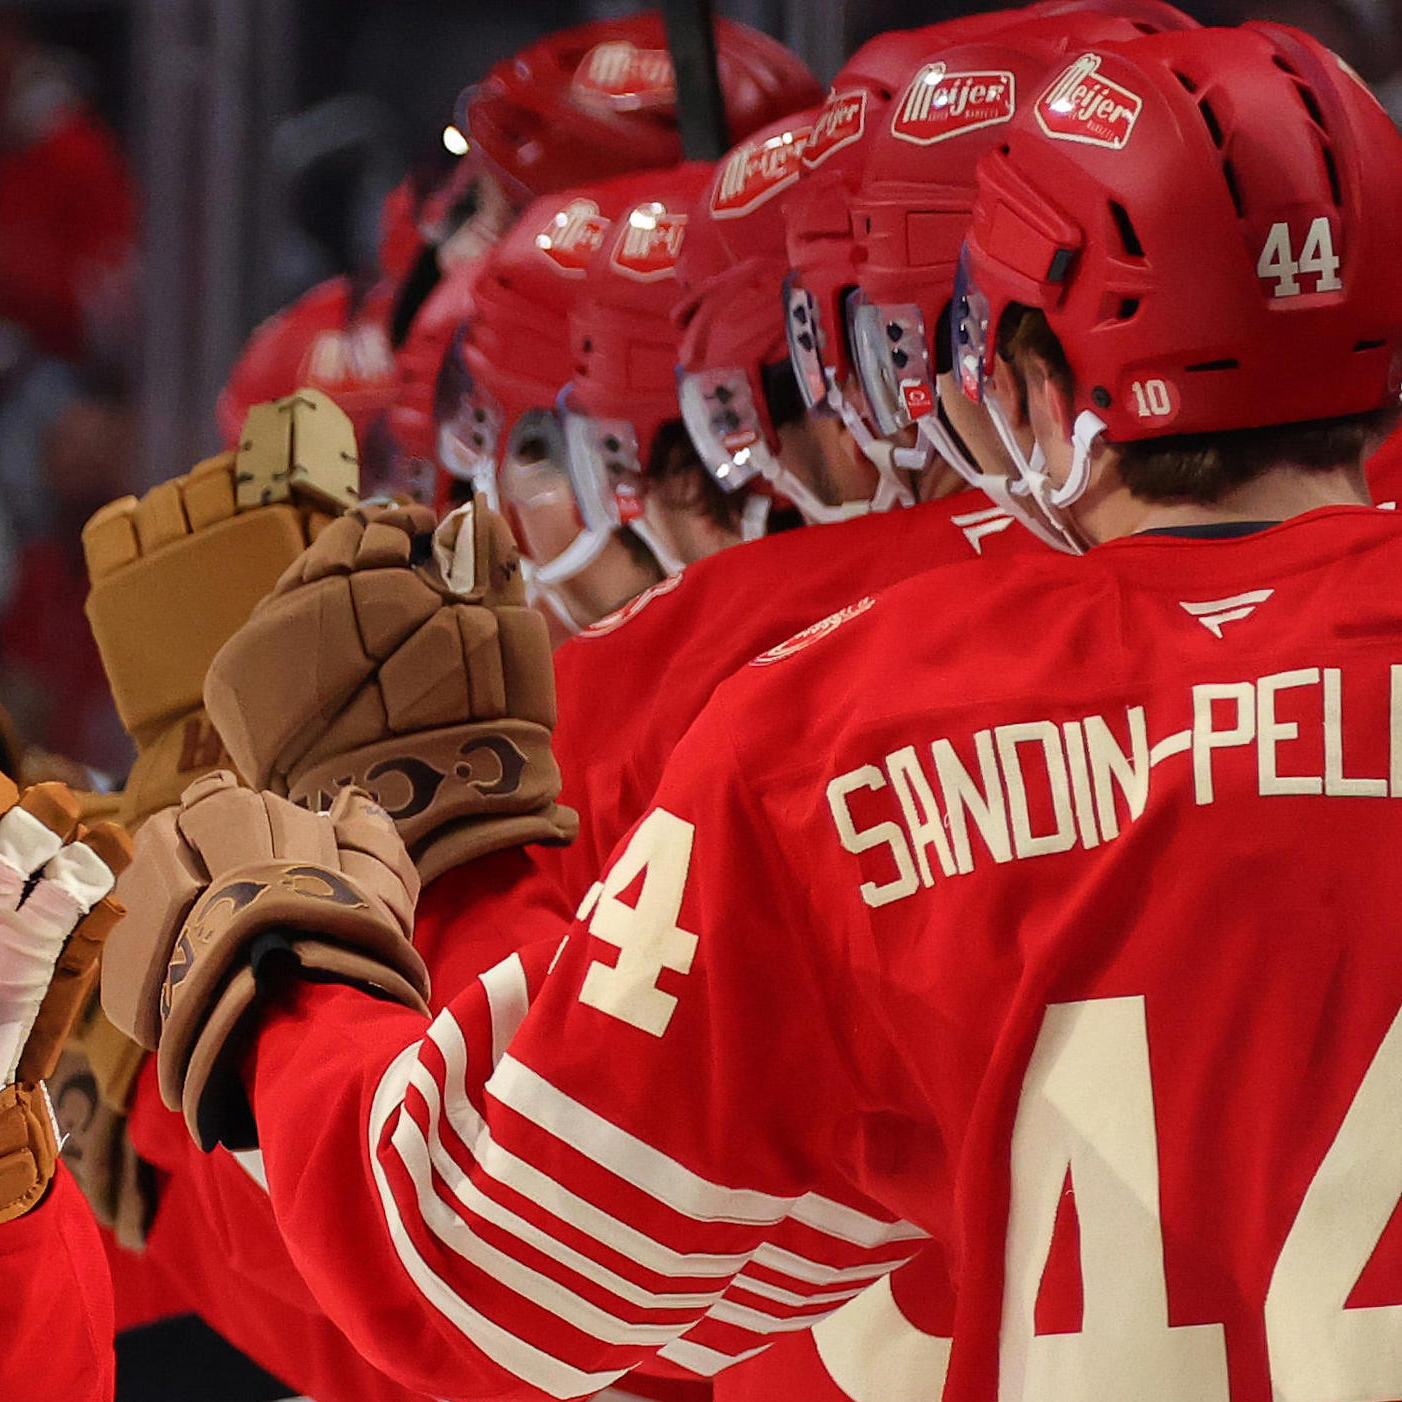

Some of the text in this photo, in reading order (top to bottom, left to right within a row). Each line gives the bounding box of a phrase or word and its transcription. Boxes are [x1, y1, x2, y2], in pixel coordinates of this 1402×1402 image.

[1257, 217, 1342, 297] 44
[1132, 380, 1171, 416] 10
[826, 664, 1402, 908] SANDIN-PEL
[548, 806, 698, 1038] 4
